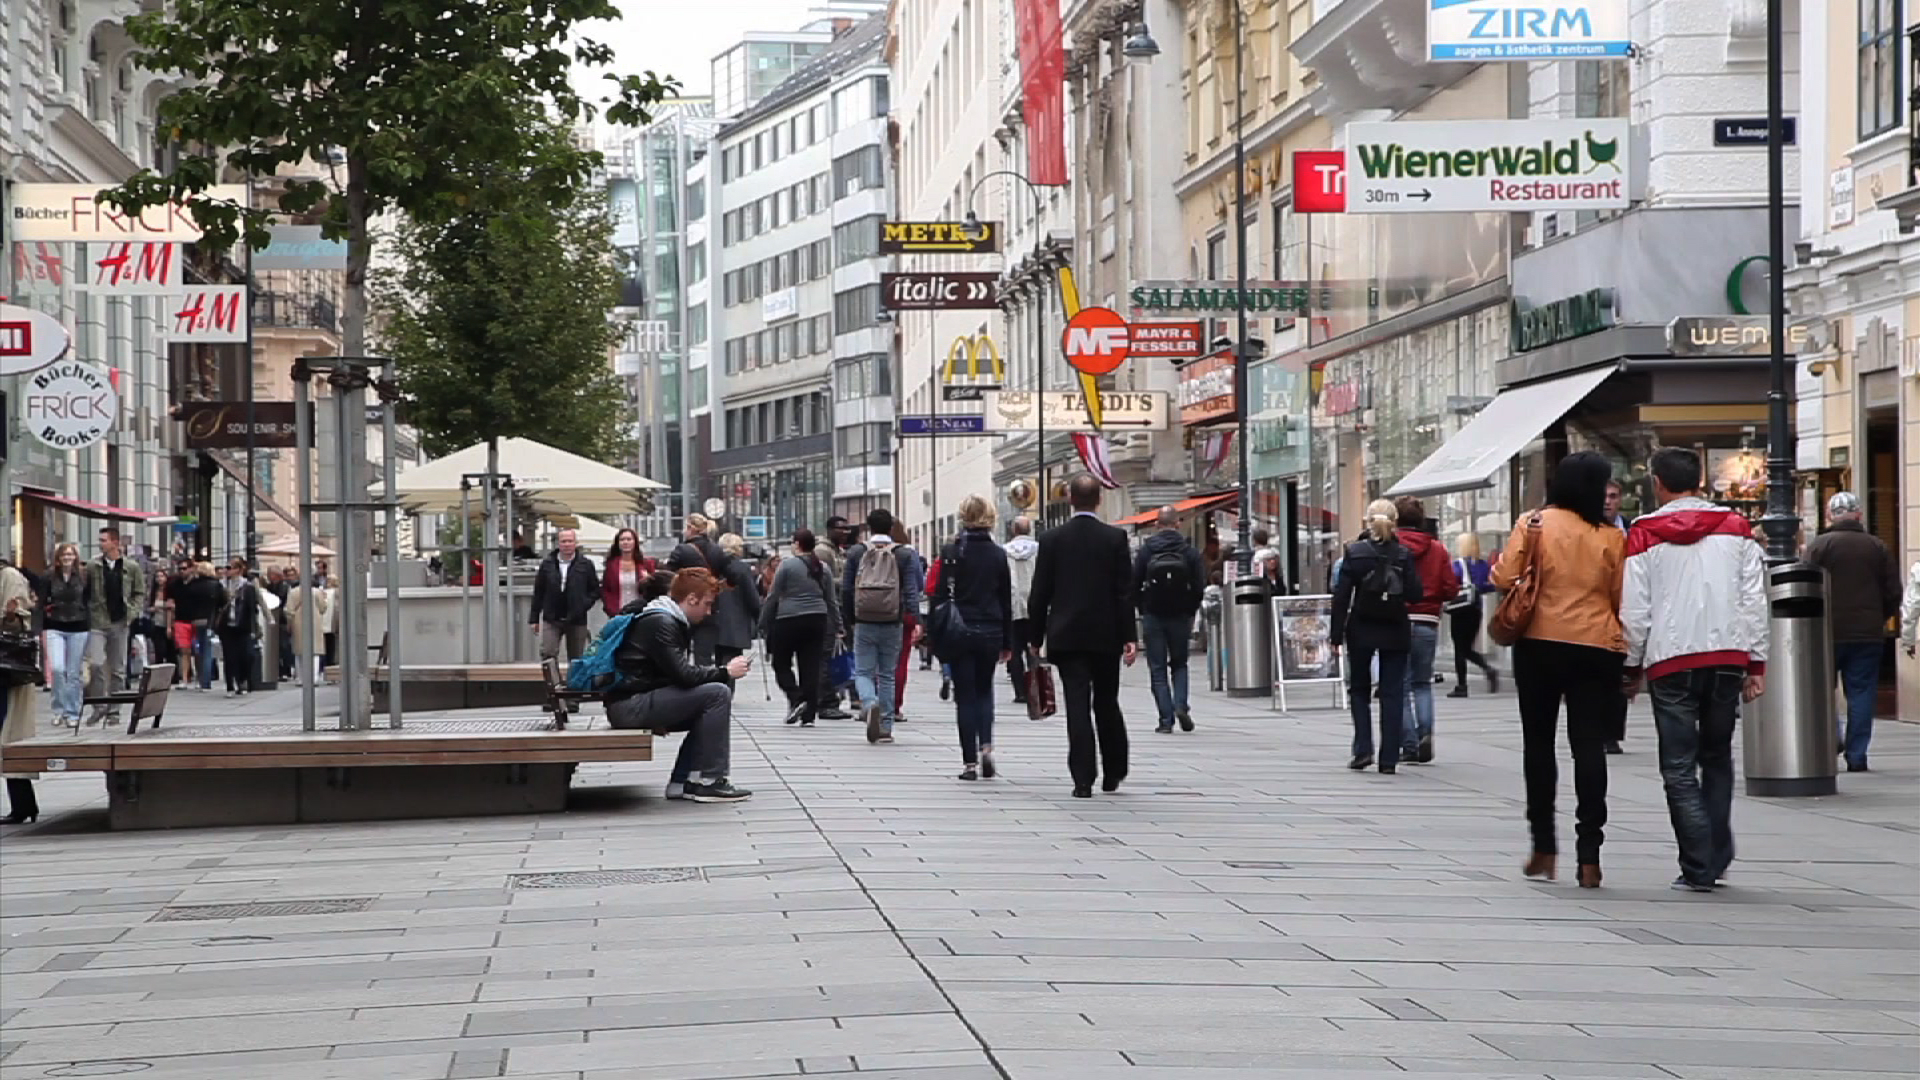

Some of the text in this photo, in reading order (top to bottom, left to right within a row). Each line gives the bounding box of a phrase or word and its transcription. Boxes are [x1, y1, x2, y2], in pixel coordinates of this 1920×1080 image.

[1467, 7, 1592, 39] ZIRM
[1454, 46, 1491, 58] augen
[1495, 46, 1504, 56] &
[1556, 44, 1606, 54] zentrum
[1365, 189, 1400, 203] 30m
[1490, 178, 1621, 201] Restaurant
[14, 206, 69, 219] Bücher
[95, 242, 173, 286] H&M
[893, 276, 959, 300] italic
[1130, 286, 1308, 312] SALAMANDER
[174, 292, 240, 334] H&M
[1066, 327, 1128, 356] MF
[1135, 328, 1192, 339] MAYR &
[1690, 325, 1808, 345] WEME
[1131, 341, 1196, 352] FESSLER
[34, 364, 104, 390] Bücher
[41, 425, 101, 446] Books
[226, 422, 277, 435] SOUENIR
